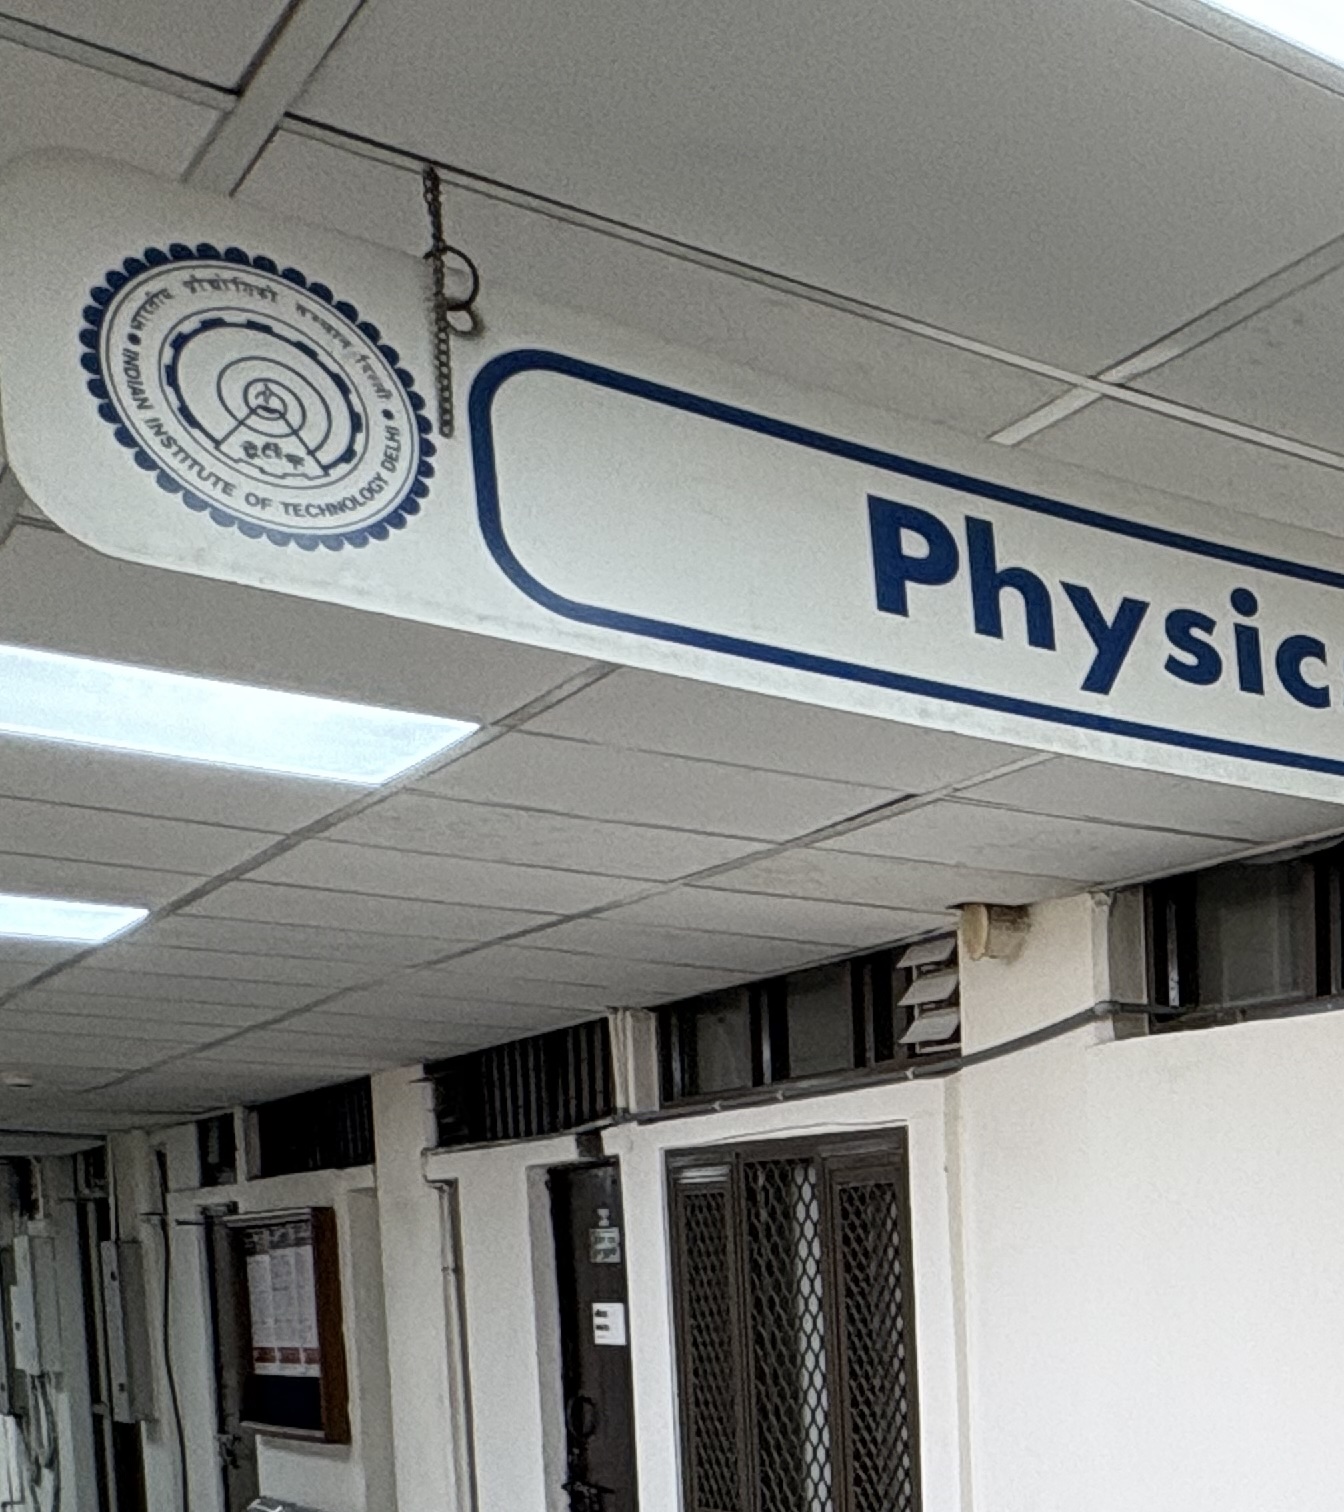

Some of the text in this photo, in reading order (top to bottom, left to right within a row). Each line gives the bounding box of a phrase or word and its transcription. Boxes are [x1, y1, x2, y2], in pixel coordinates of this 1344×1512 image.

[122, 348, 154, 410] INDIAN
[144, 417, 237, 497] INSTITUTE
[245, 492, 272, 510] OF
[280, 471, 389, 518] TECHNOLOGY
[381, 425, 401, 473] DELHI
